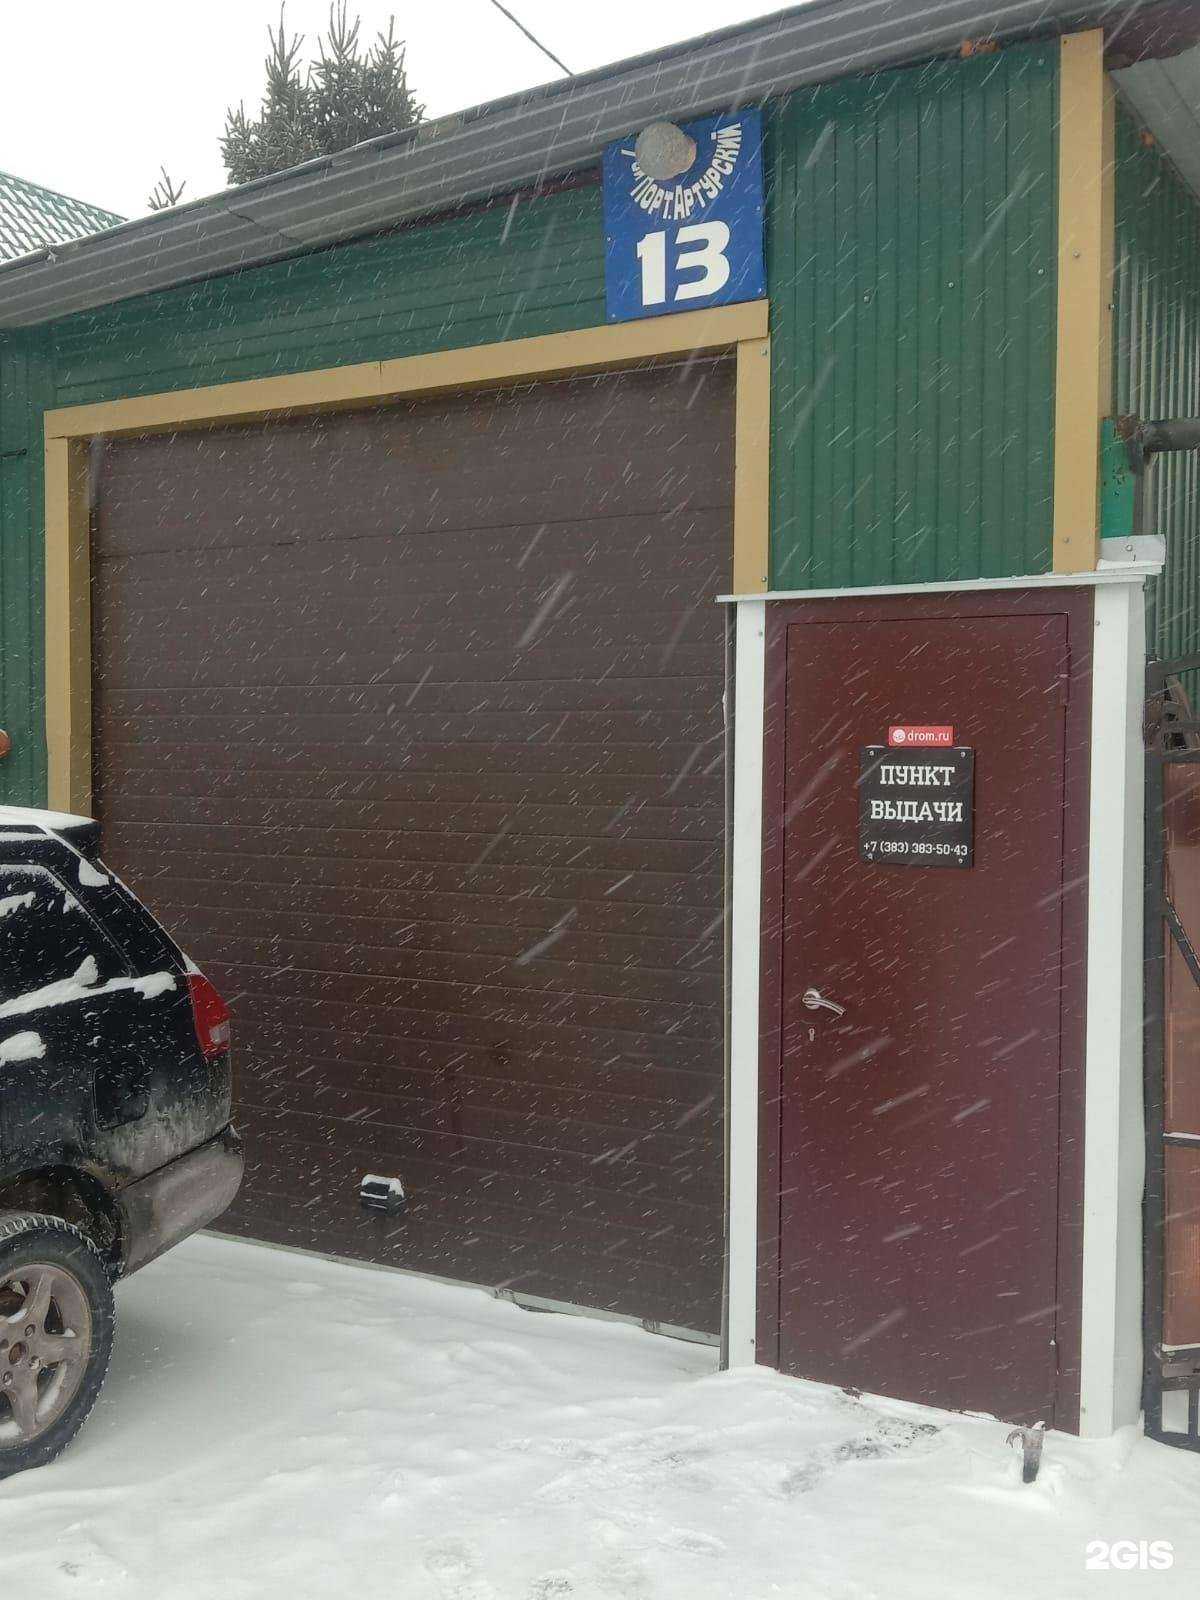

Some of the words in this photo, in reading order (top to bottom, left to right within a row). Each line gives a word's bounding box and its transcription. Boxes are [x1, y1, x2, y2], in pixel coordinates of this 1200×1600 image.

[636, 221, 731, 306] 13
[907, 731, 950, 741] drom.ru
[880, 765, 955, 786] ПУНКТ
[870, 799, 963, 823] ВЫДАЧИ
[863, 841, 878, 852] +7
[879, 841, 909, 854] (383)
[911, 842, 968, 856] 383-50-43
